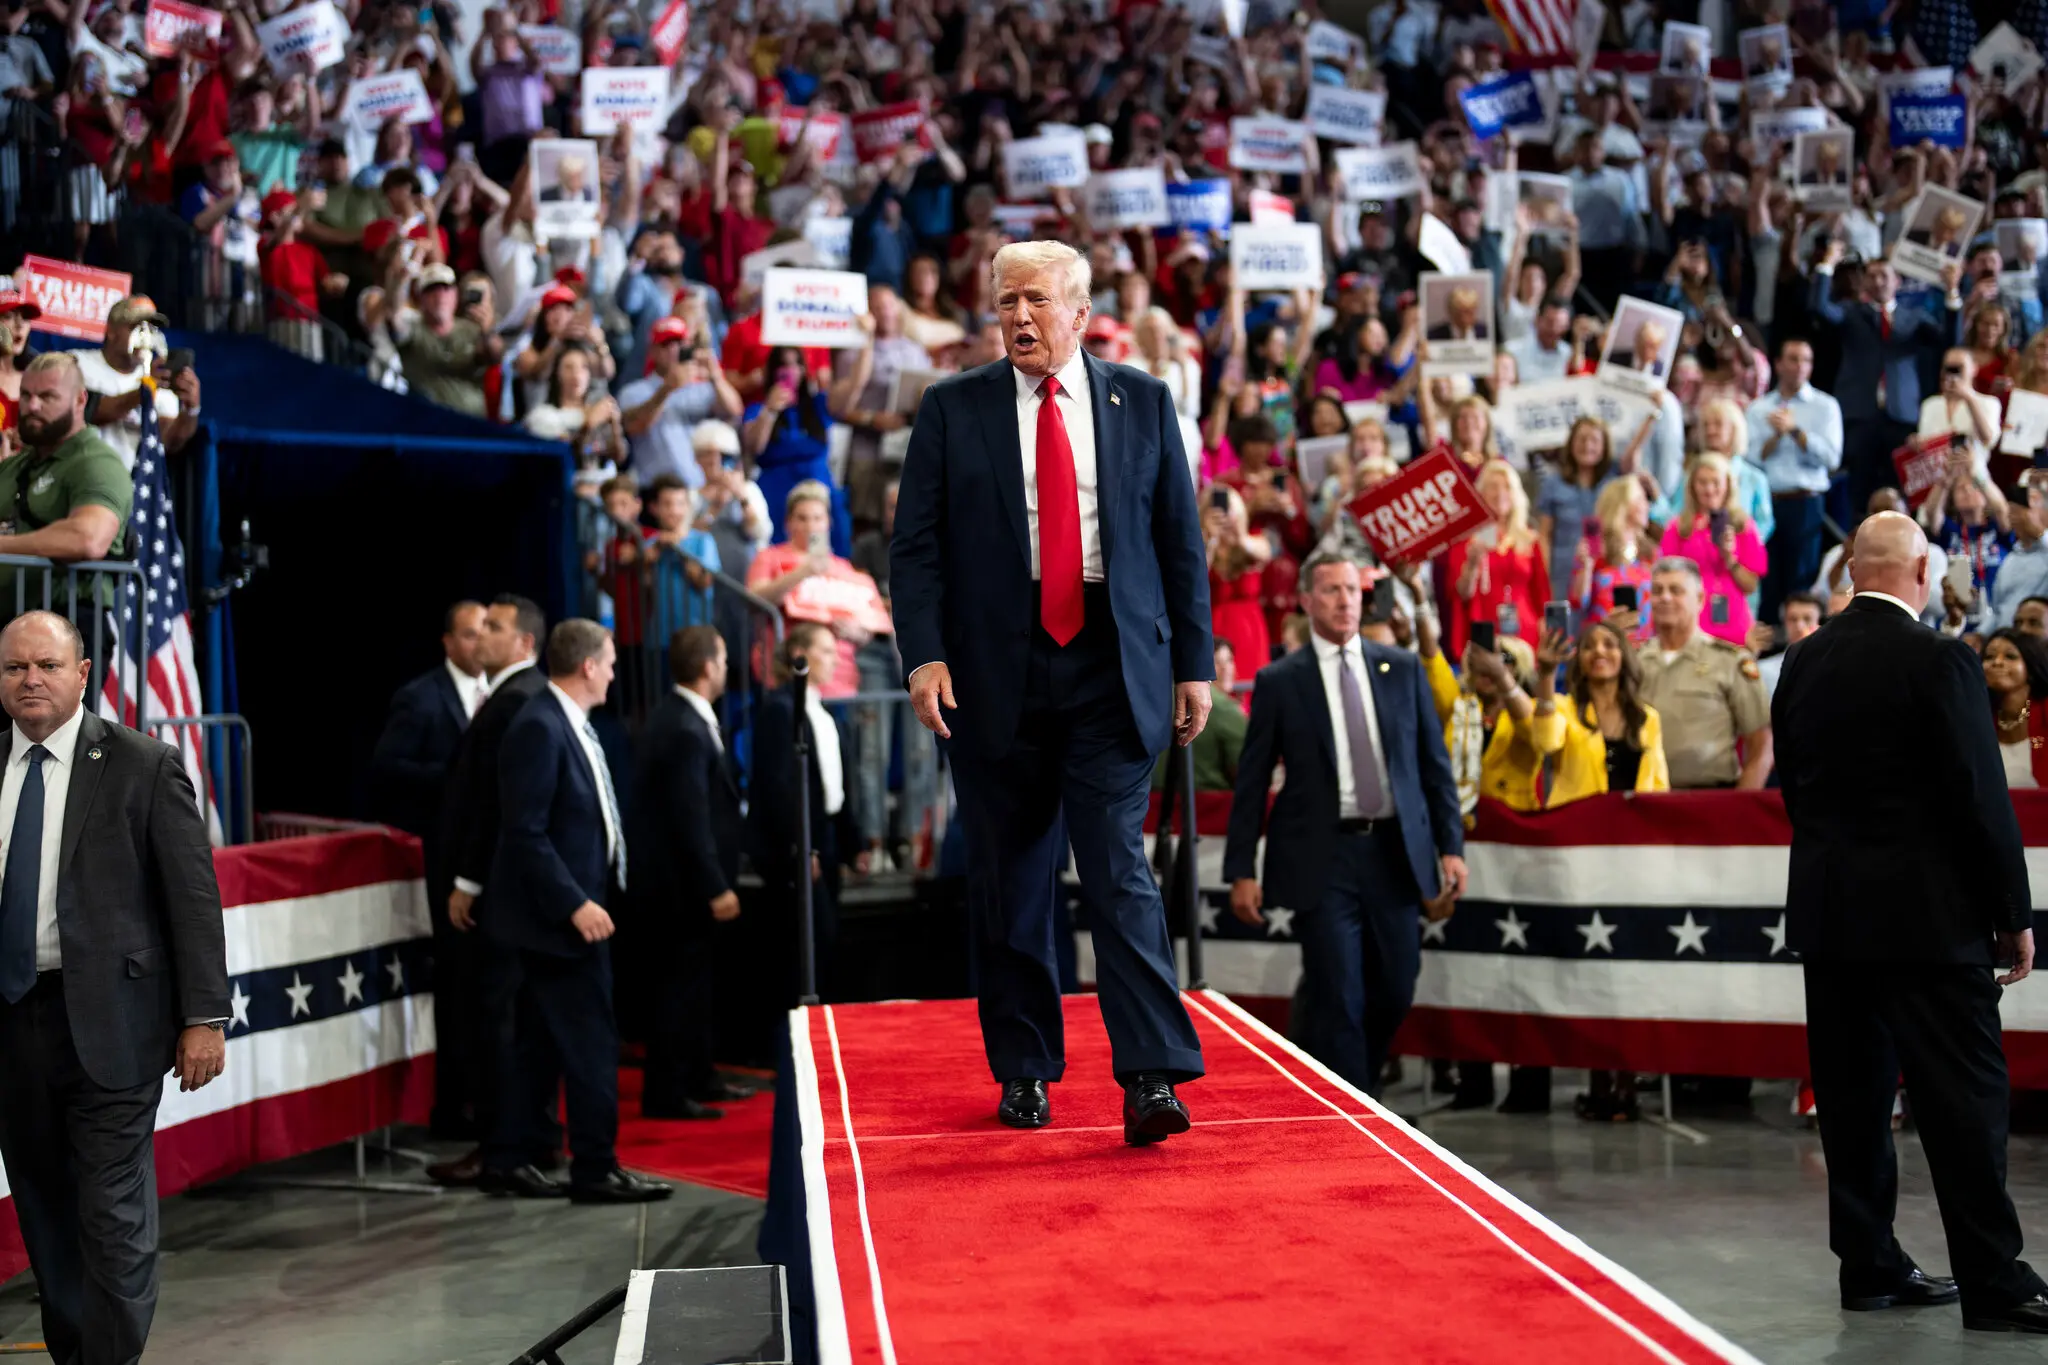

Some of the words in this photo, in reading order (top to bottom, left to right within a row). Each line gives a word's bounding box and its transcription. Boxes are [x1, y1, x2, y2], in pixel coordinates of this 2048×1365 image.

[609, 79, 647, 91] VOTE
[28, 271, 123, 308] TRUMP
[795, 284, 840, 298] VOTE
[1361, 469, 1458, 538] TRUMP
[1379, 495, 1461, 549] VANCE
